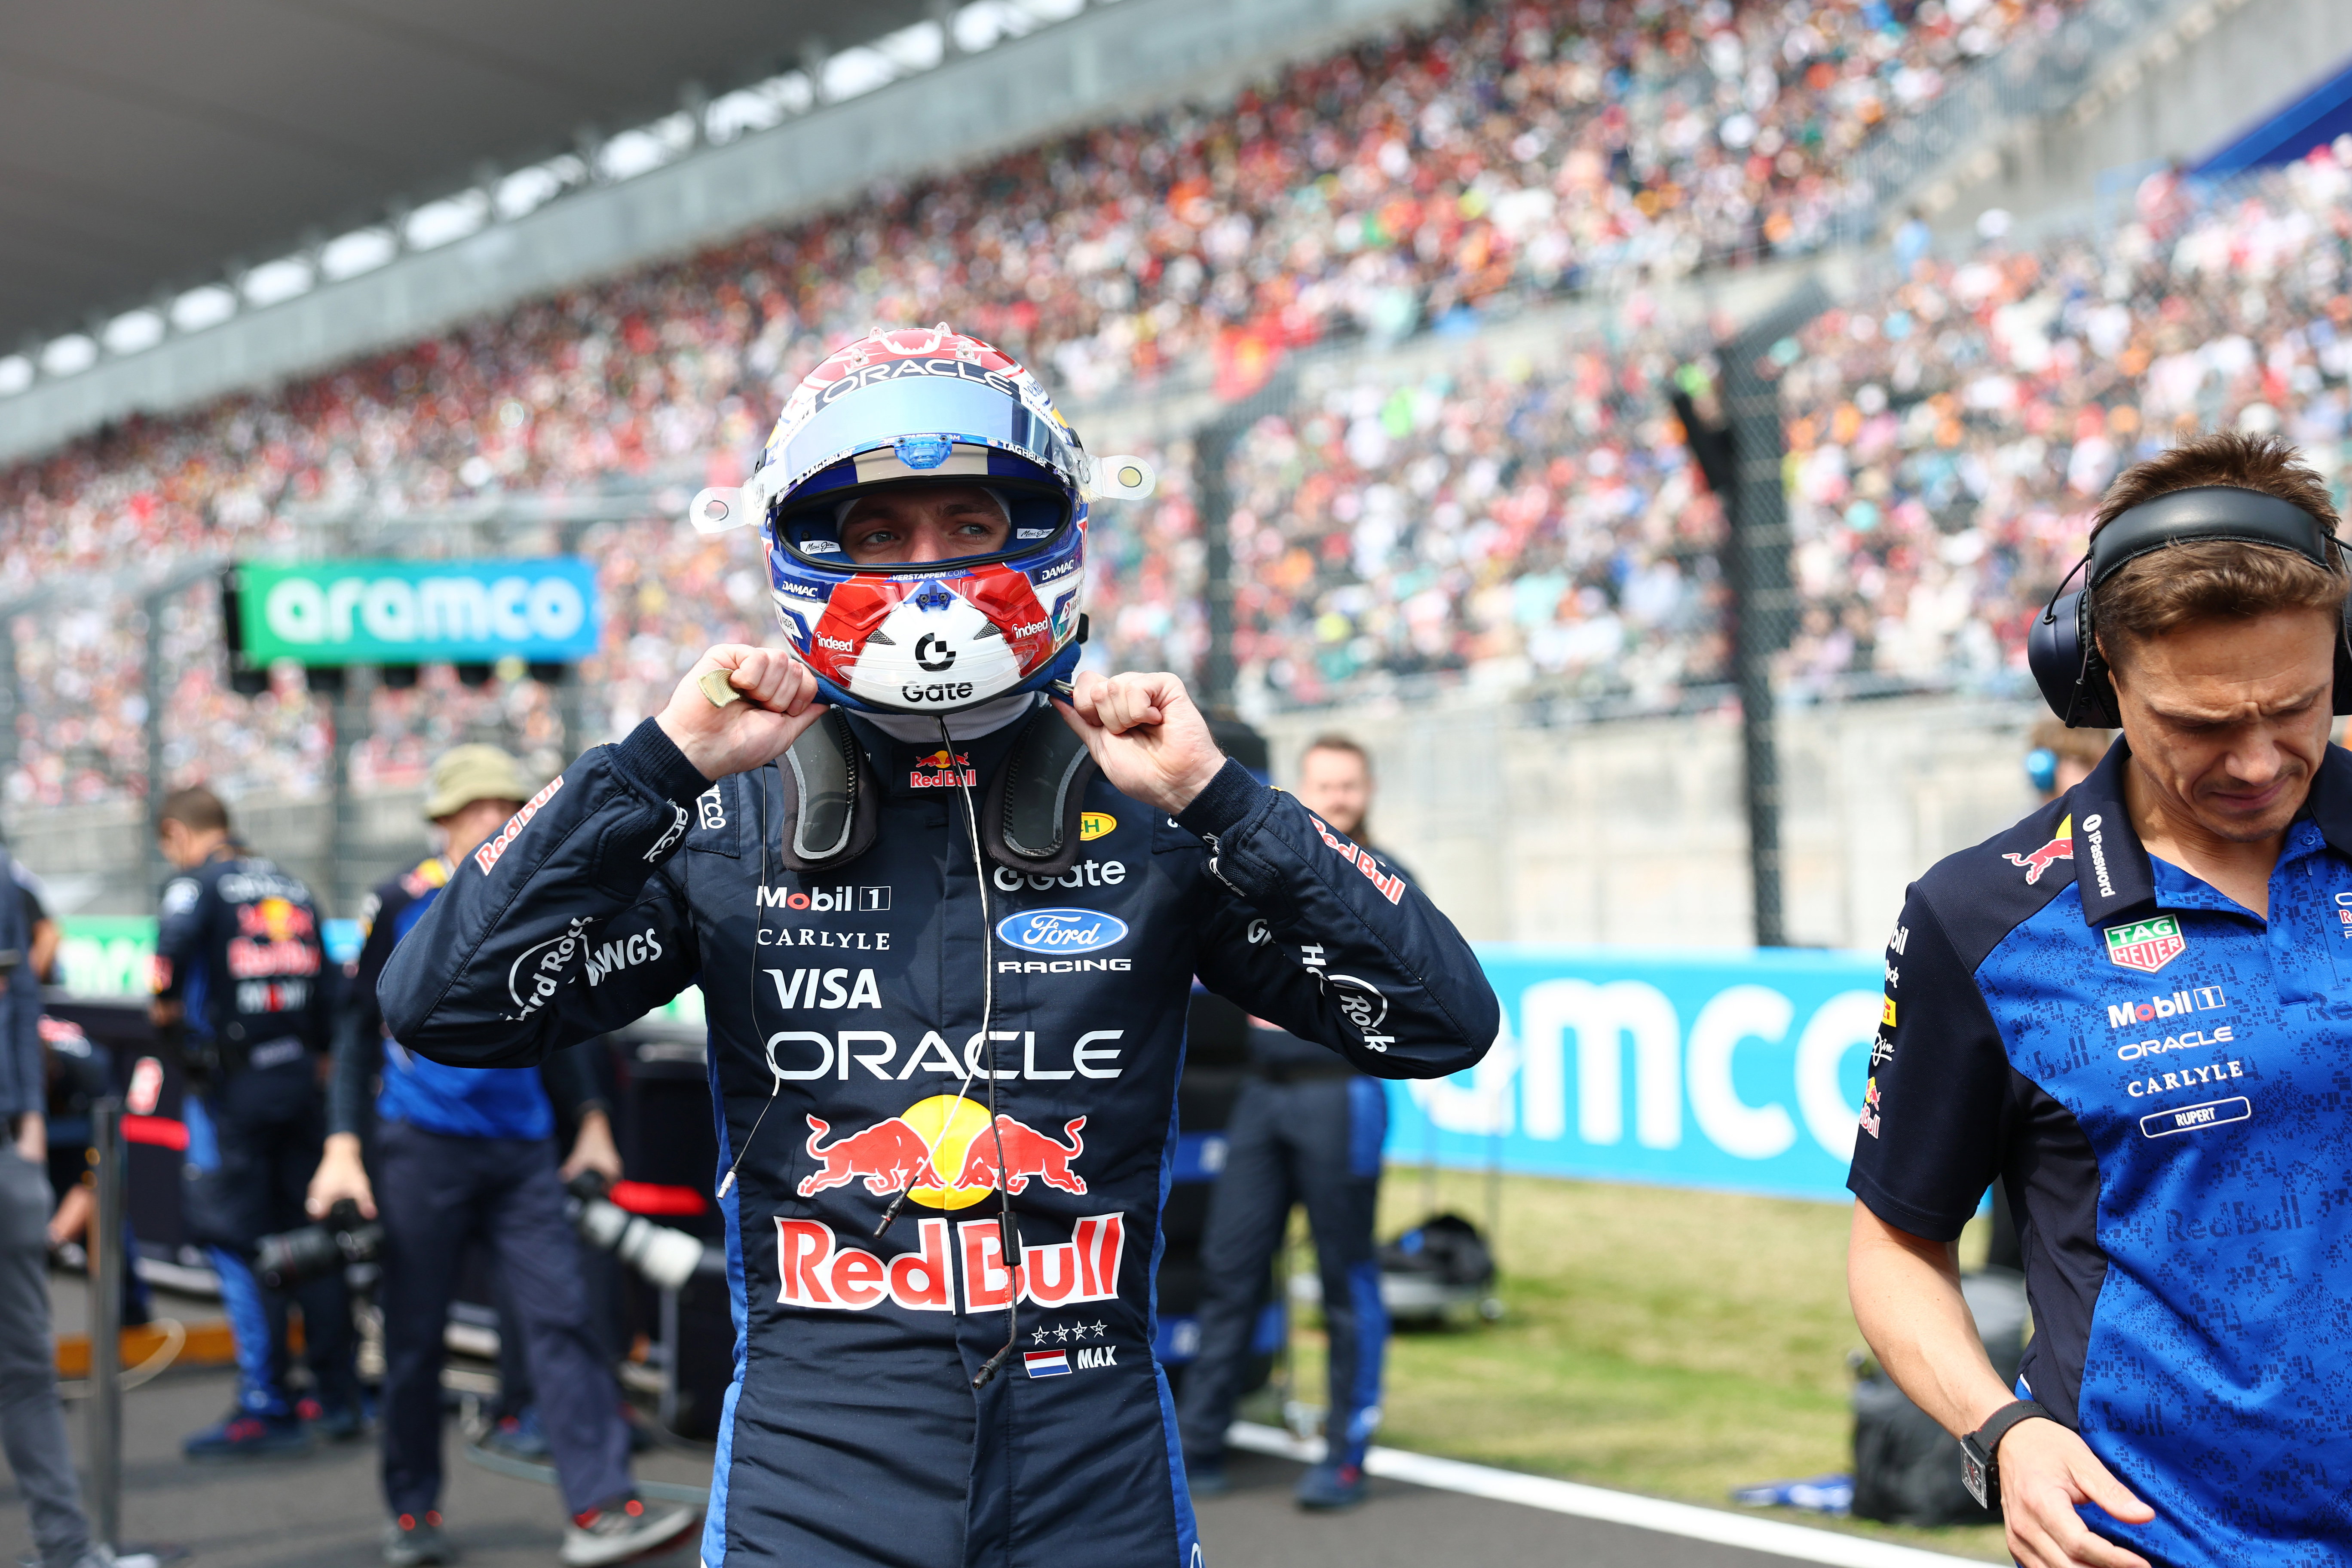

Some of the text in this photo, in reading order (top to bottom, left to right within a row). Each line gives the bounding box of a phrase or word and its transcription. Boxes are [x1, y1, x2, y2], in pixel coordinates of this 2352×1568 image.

[823, 358, 1013, 403] ORACLE
[805, 542, 835, 551] Maui Jim
[892, 569, 966, 581] VERSTAPPEN.COM
[1042, 560, 1074, 580] DAMAC
[782, 581, 818, 597] DAMAC
[264, 575, 585, 643] aramco
[815, 631, 853, 652] indeed
[1012, 616, 1048, 639] indeed
[902, 681, 973, 702] Gate
[910, 769, 943, 788] Red
[701, 784, 726, 829] arco
[475, 815, 523, 876] Red
[1357, 850, 1406, 905] Bull
[756, 886, 852, 911] Mobil
[756, 928, 890, 950] CARLYLE
[1030, 915, 1101, 945] Ford
[1889, 922, 1909, 956] bil
[2110, 917, 2173, 944] TAG
[998, 959, 1131, 974] RACING
[2114, 937, 2179, 969] HEUER
[763, 968, 882, 1009] VISA
[1339, 995, 1395, 1052] Rock
[2107, 990, 2192, 1028] Mobil
[766, 1030, 1124, 1080] ORACLE
[2117, 1026, 2234, 1060] ORACLE
[2128, 1061, 2243, 1097] CARLYLE
[2175, 1107, 2215, 1127] RUPERT
[774, 1216, 956, 1315] Red
[957, 1212, 1124, 1314] Bull
[1077, 1345, 1118, 1369] MAX
